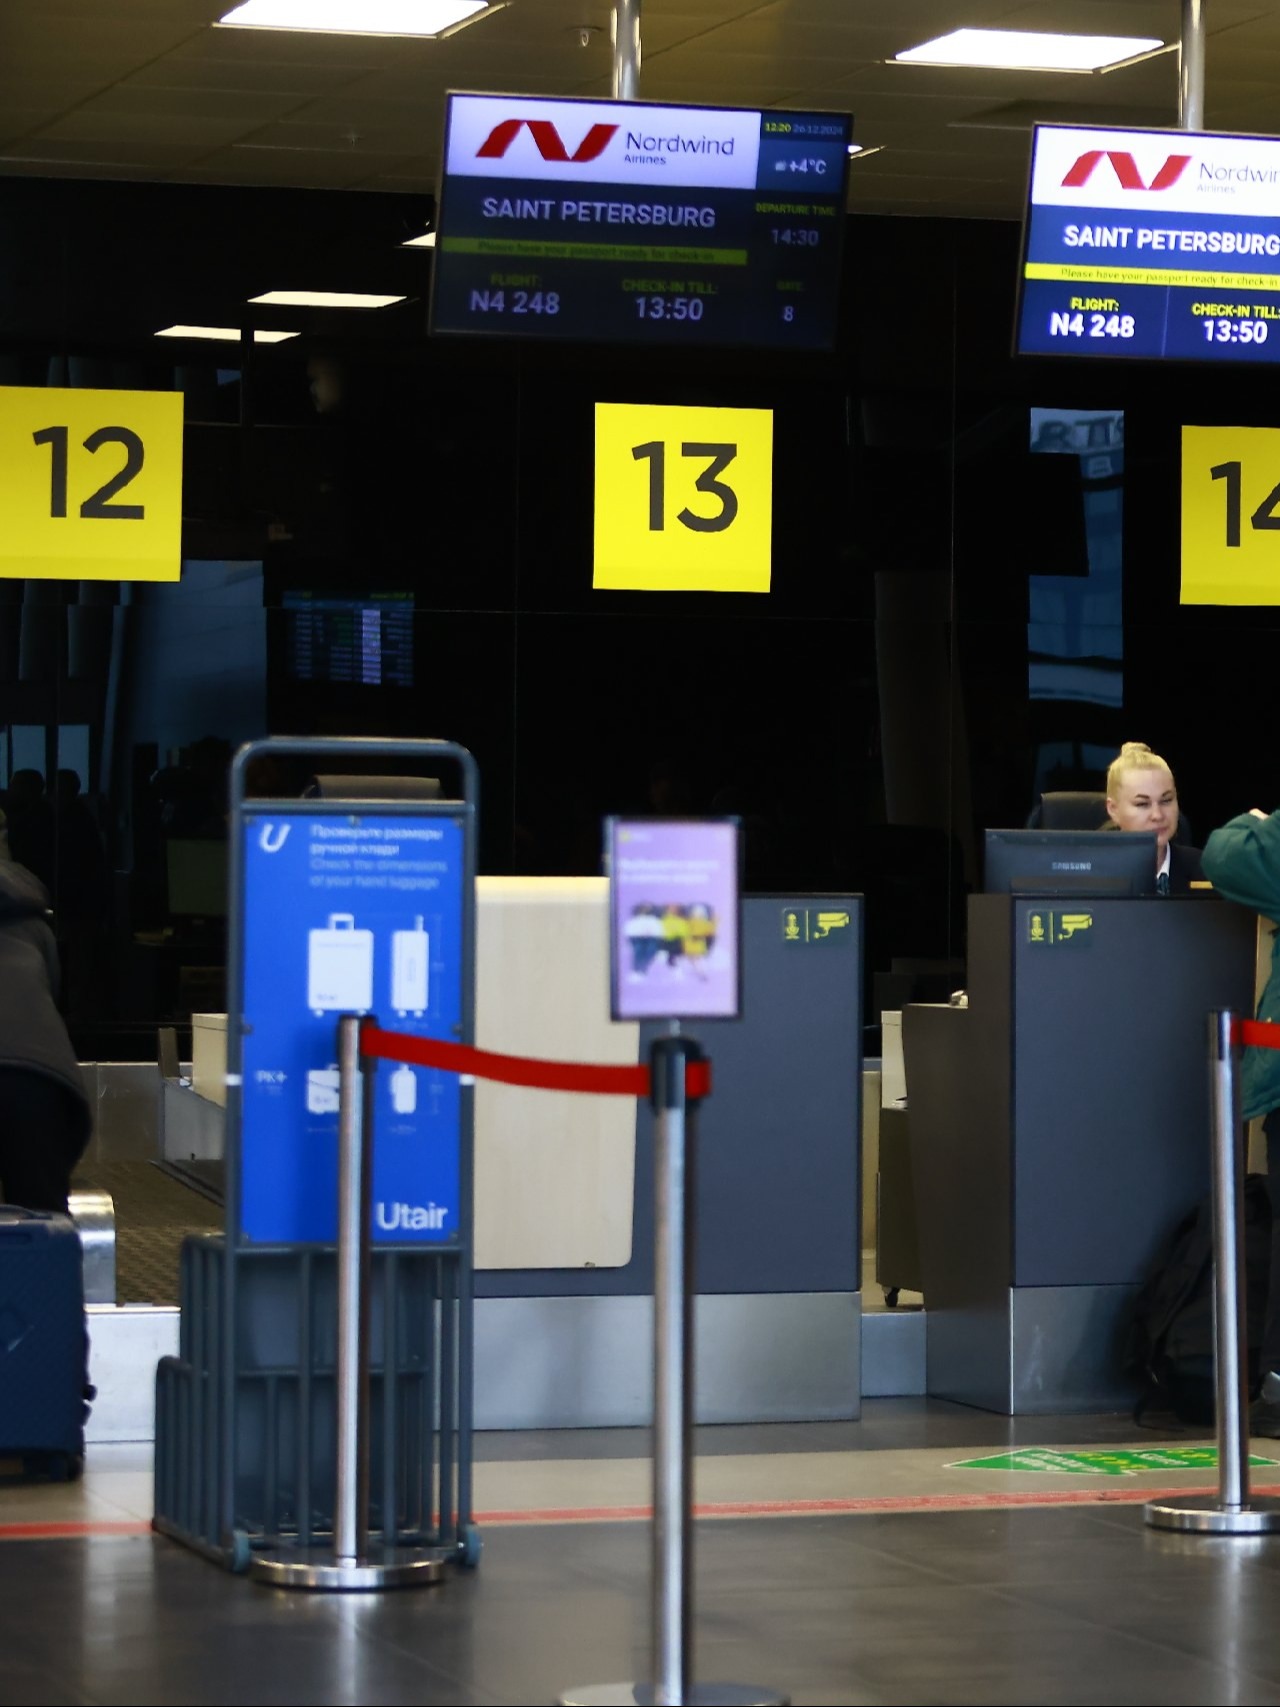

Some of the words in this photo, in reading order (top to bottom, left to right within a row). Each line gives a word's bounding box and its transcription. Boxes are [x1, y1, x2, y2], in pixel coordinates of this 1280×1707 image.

[626, 132, 735, 156] Nordwind
[624, 154, 667, 166] Airlines
[1196, 183, 1236, 195] Airlines
[482, 197, 555, 221] SAINT
[561, 201, 717, 229] PETERSBURG
[755, 202, 808, 215] DEPARTURE
[771, 228, 819, 246] 14:30
[1064, 225, 1133, 249] SAINT
[1137, 229, 1280, 256] PETERSBURG
[622, 278, 685, 293] CHECK-IN
[1061, 267, 1095, 279] Please
[1098, 269, 1119, 280] have
[1121, 271, 1144, 283] your
[1146, 272, 1188, 285] passport
[1190, 275, 1218, 288] ready
[1220, 275, 1235, 286] for
[1237, 276, 1278, 288] check-in
[470, 290, 505, 313] N4
[512, 291, 560, 315] 248
[635, 297, 704, 321] 13:50
[782, 305, 794, 322] 8
[1071, 298, 1120, 312] FLIGHT:
[1192, 303, 1252, 318] CHECK-IN
[1050, 312, 1084, 337] N4
[1090, 313, 1135, 338] 248
[1204, 320, 1268, 344] 13:50
[32, 425, 145, 520] 12
[632, 441, 740, 533] 13
[1052, 862, 1091, 871] SAMSUNG
[377, 1202, 448, 1230] Utair
